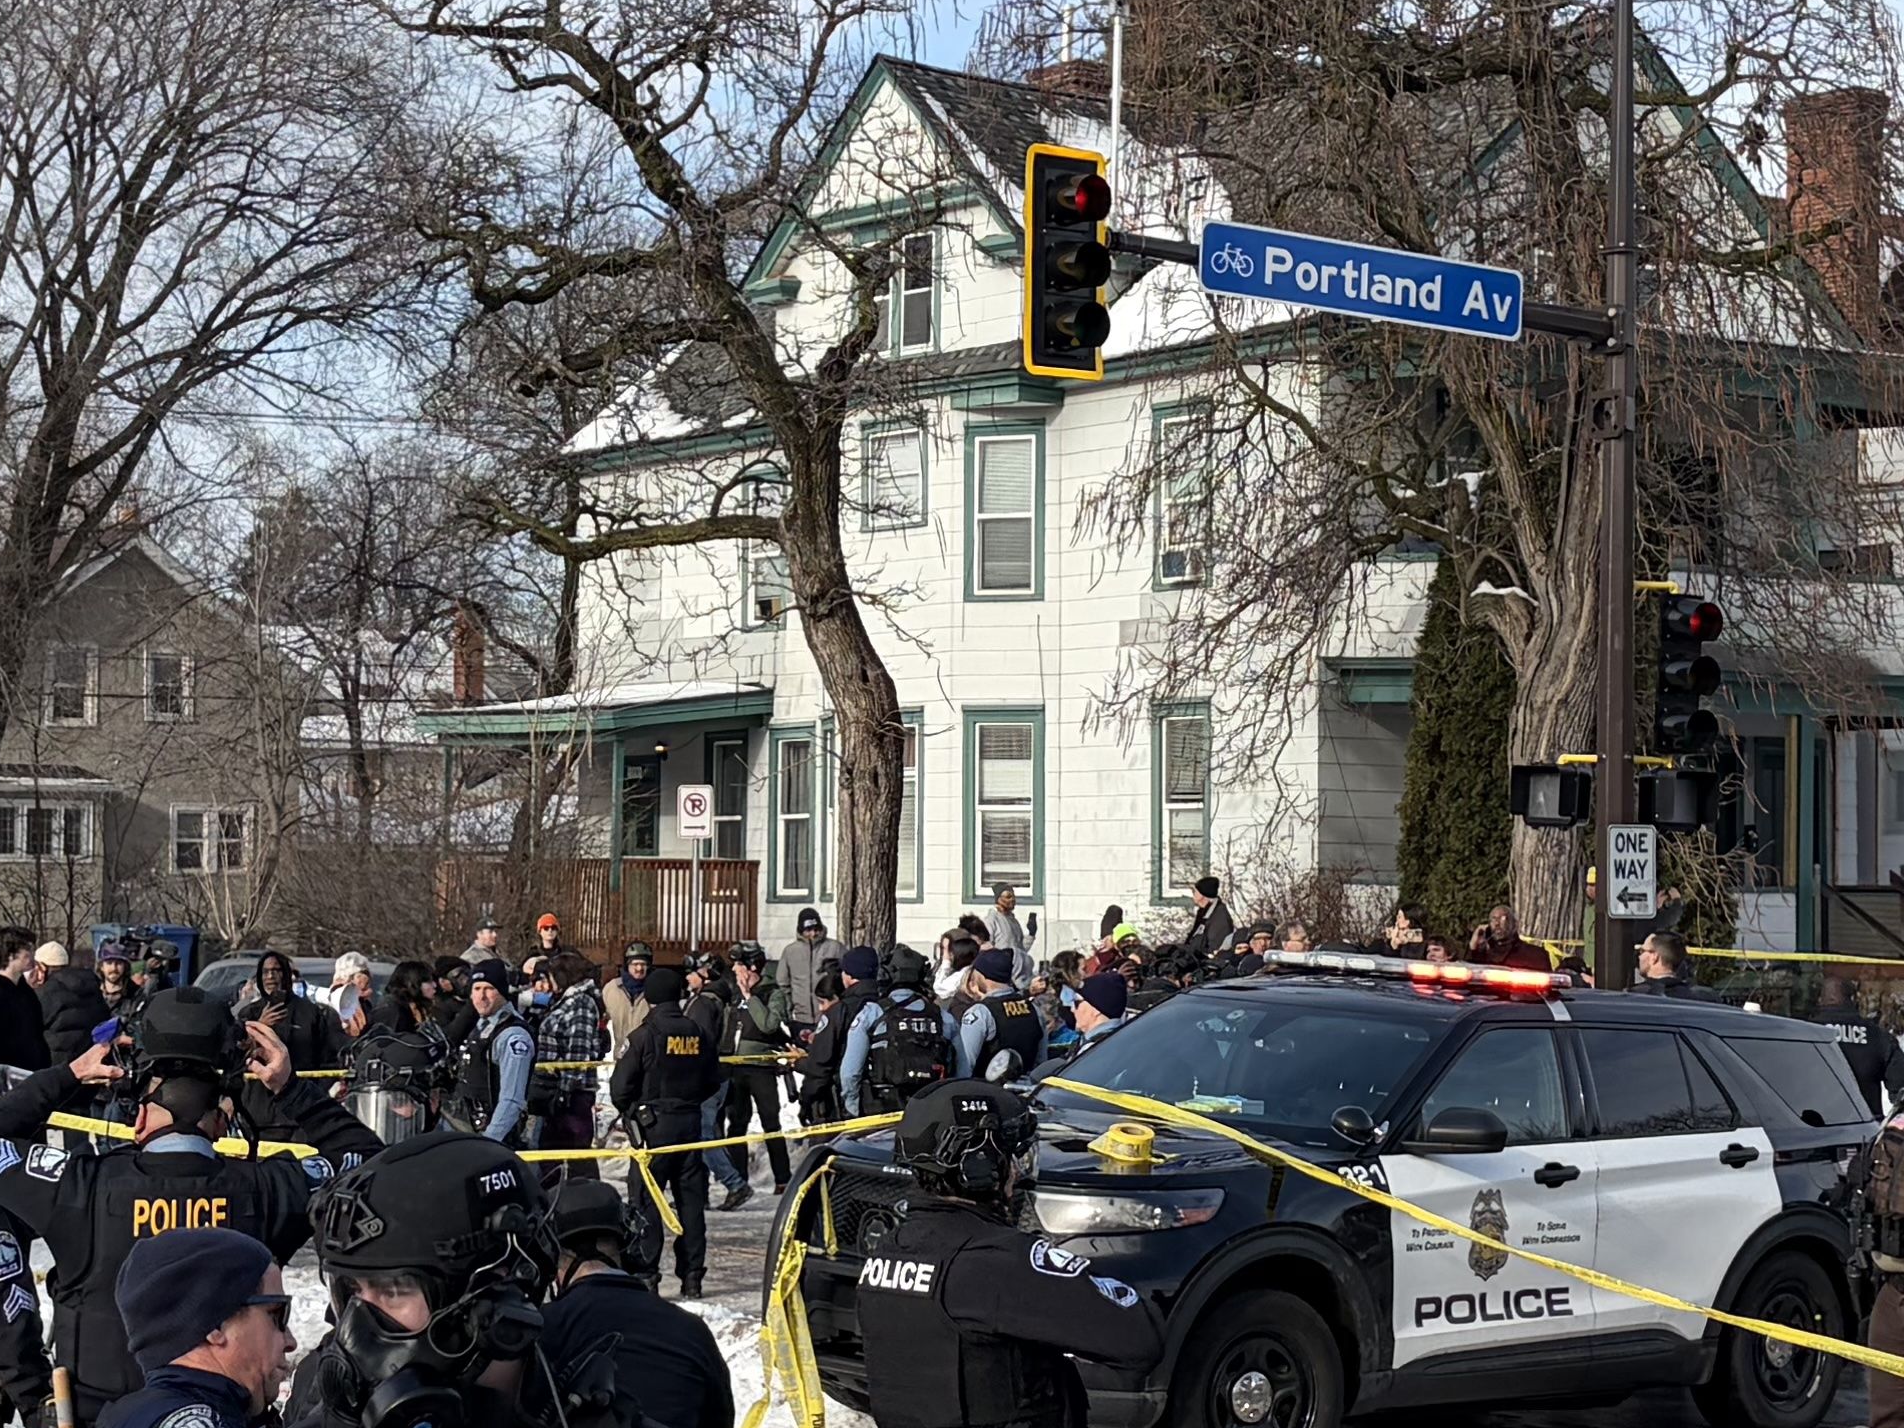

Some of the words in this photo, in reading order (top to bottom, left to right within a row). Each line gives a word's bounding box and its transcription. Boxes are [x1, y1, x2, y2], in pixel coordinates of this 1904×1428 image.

[1264, 245, 1442, 312] Portland
[1461, 280, 1513, 324] Av
[1615, 832, 1649, 853] ONE
[1613, 858, 1649, 880] WAY
[1002, 999, 1032, 1018] POLICE
[666, 1035, 700, 1055] POLICE
[479, 1169, 517, 1193] 7501
[132, 1197, 227, 1238] POLICE
[858, 1257, 935, 1292] POLICE
[1414, 1286, 1574, 1328] POLICE
